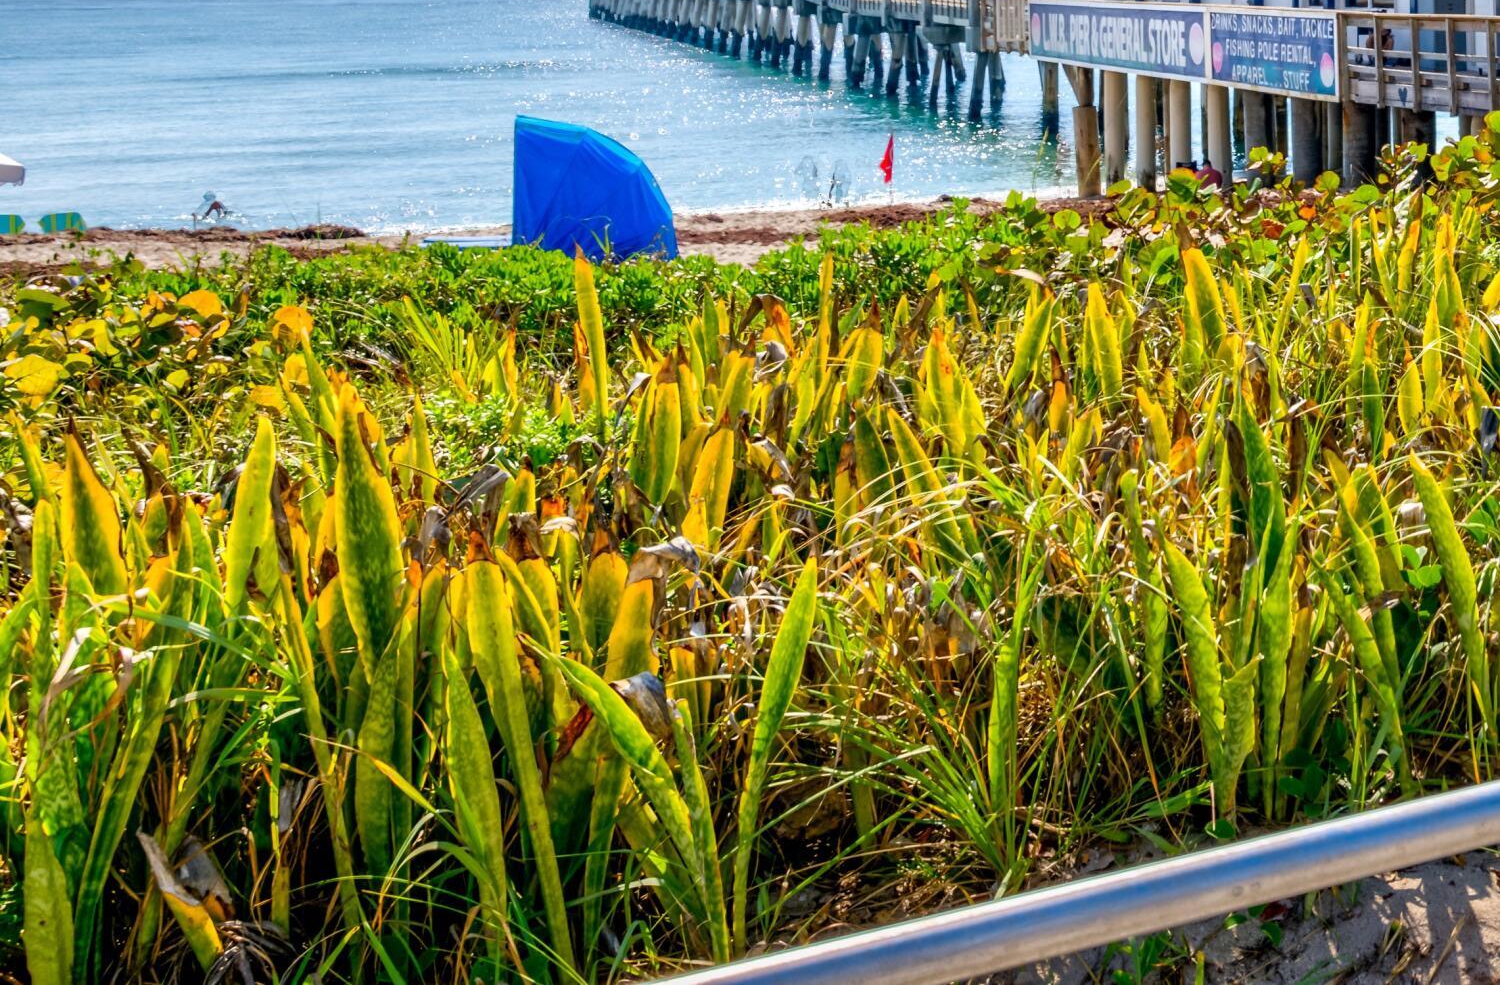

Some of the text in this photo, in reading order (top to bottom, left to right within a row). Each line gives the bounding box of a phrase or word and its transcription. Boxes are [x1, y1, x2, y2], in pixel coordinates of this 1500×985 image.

[1242, 15, 1276, 37] SNACKS,
[1301, 19, 1334, 38] TACKLE
[1070, 14, 1090, 56] PIER
[1091, 15, 1099, 57] &
[1101, 16, 1147, 62] GENERAL
[1149, 19, 1186, 66] STORE
[1225, 38, 1316, 67] FISHING POLE RENTAL,
[1283, 70, 1310, 90] STUFF
